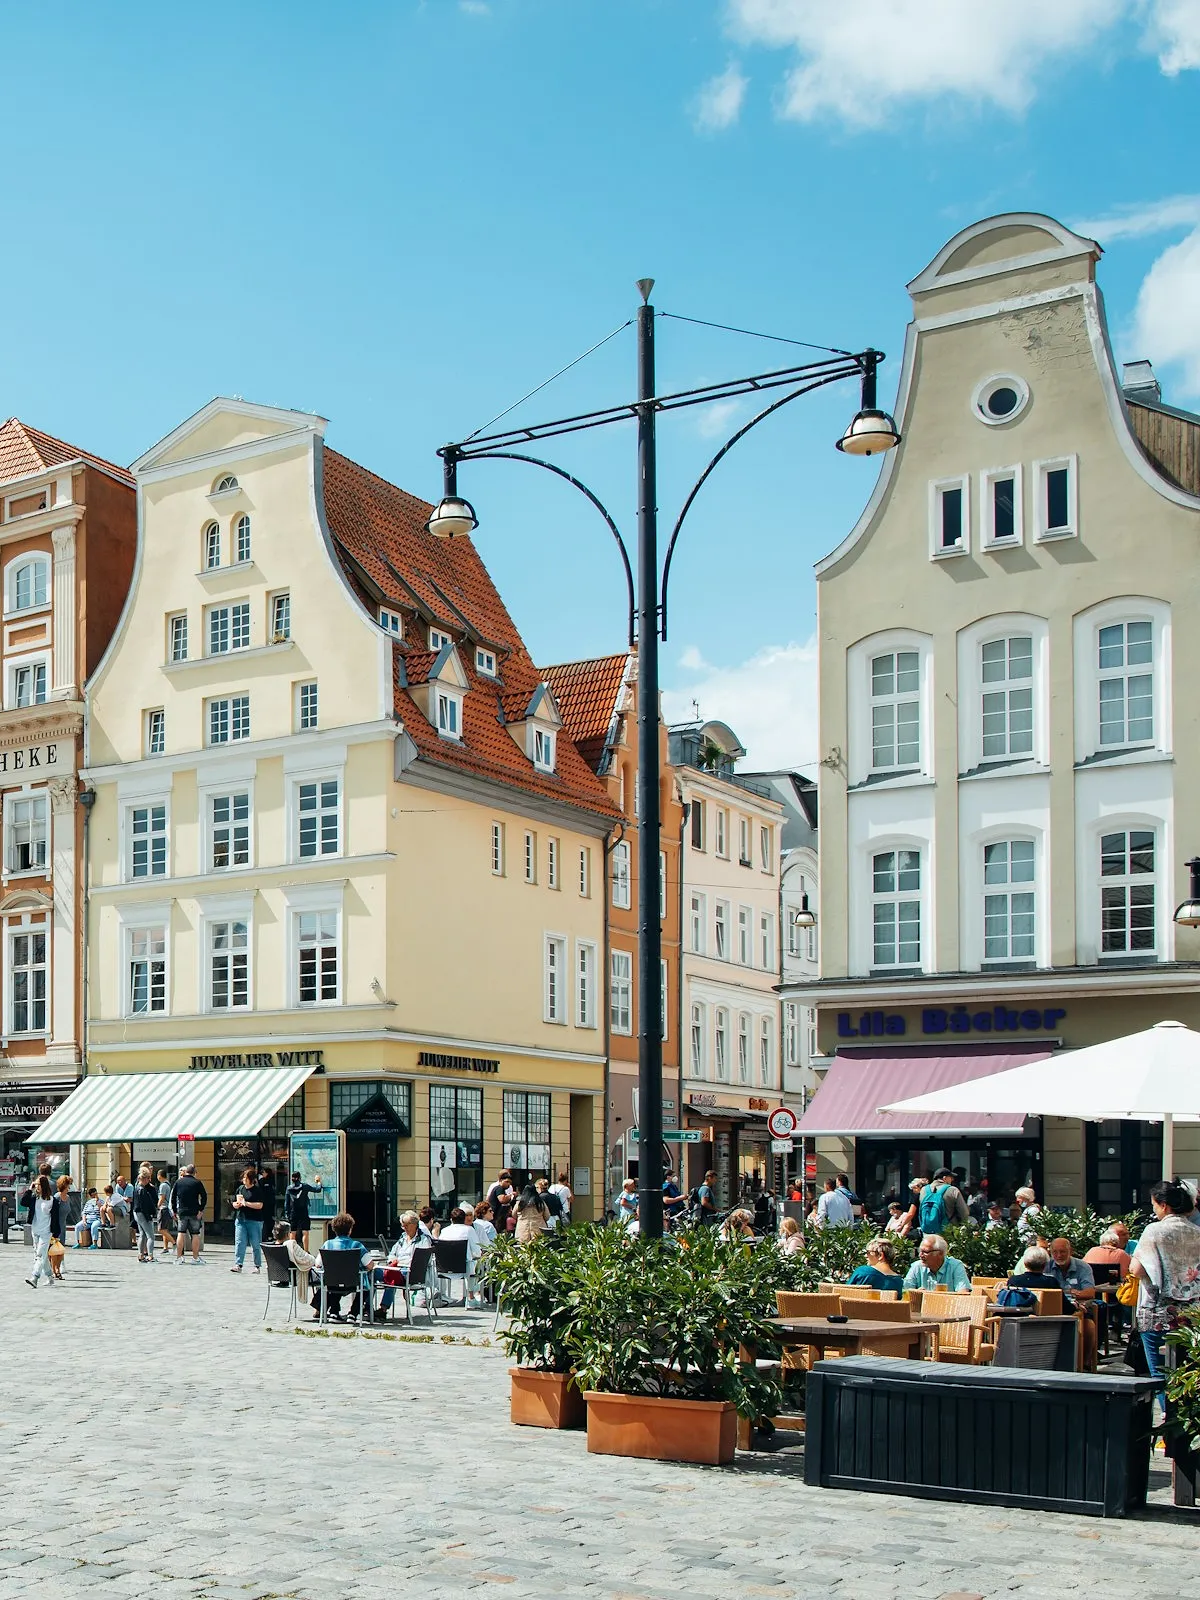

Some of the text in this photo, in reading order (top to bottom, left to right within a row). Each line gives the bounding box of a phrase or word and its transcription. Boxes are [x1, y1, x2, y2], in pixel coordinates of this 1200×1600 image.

[837, 1005, 1066, 1038] Lila Bäcker
[188, 1050, 323, 1071] JUWELIER WITT
[417, 1052, 500, 1073] JUWELIER WITT
